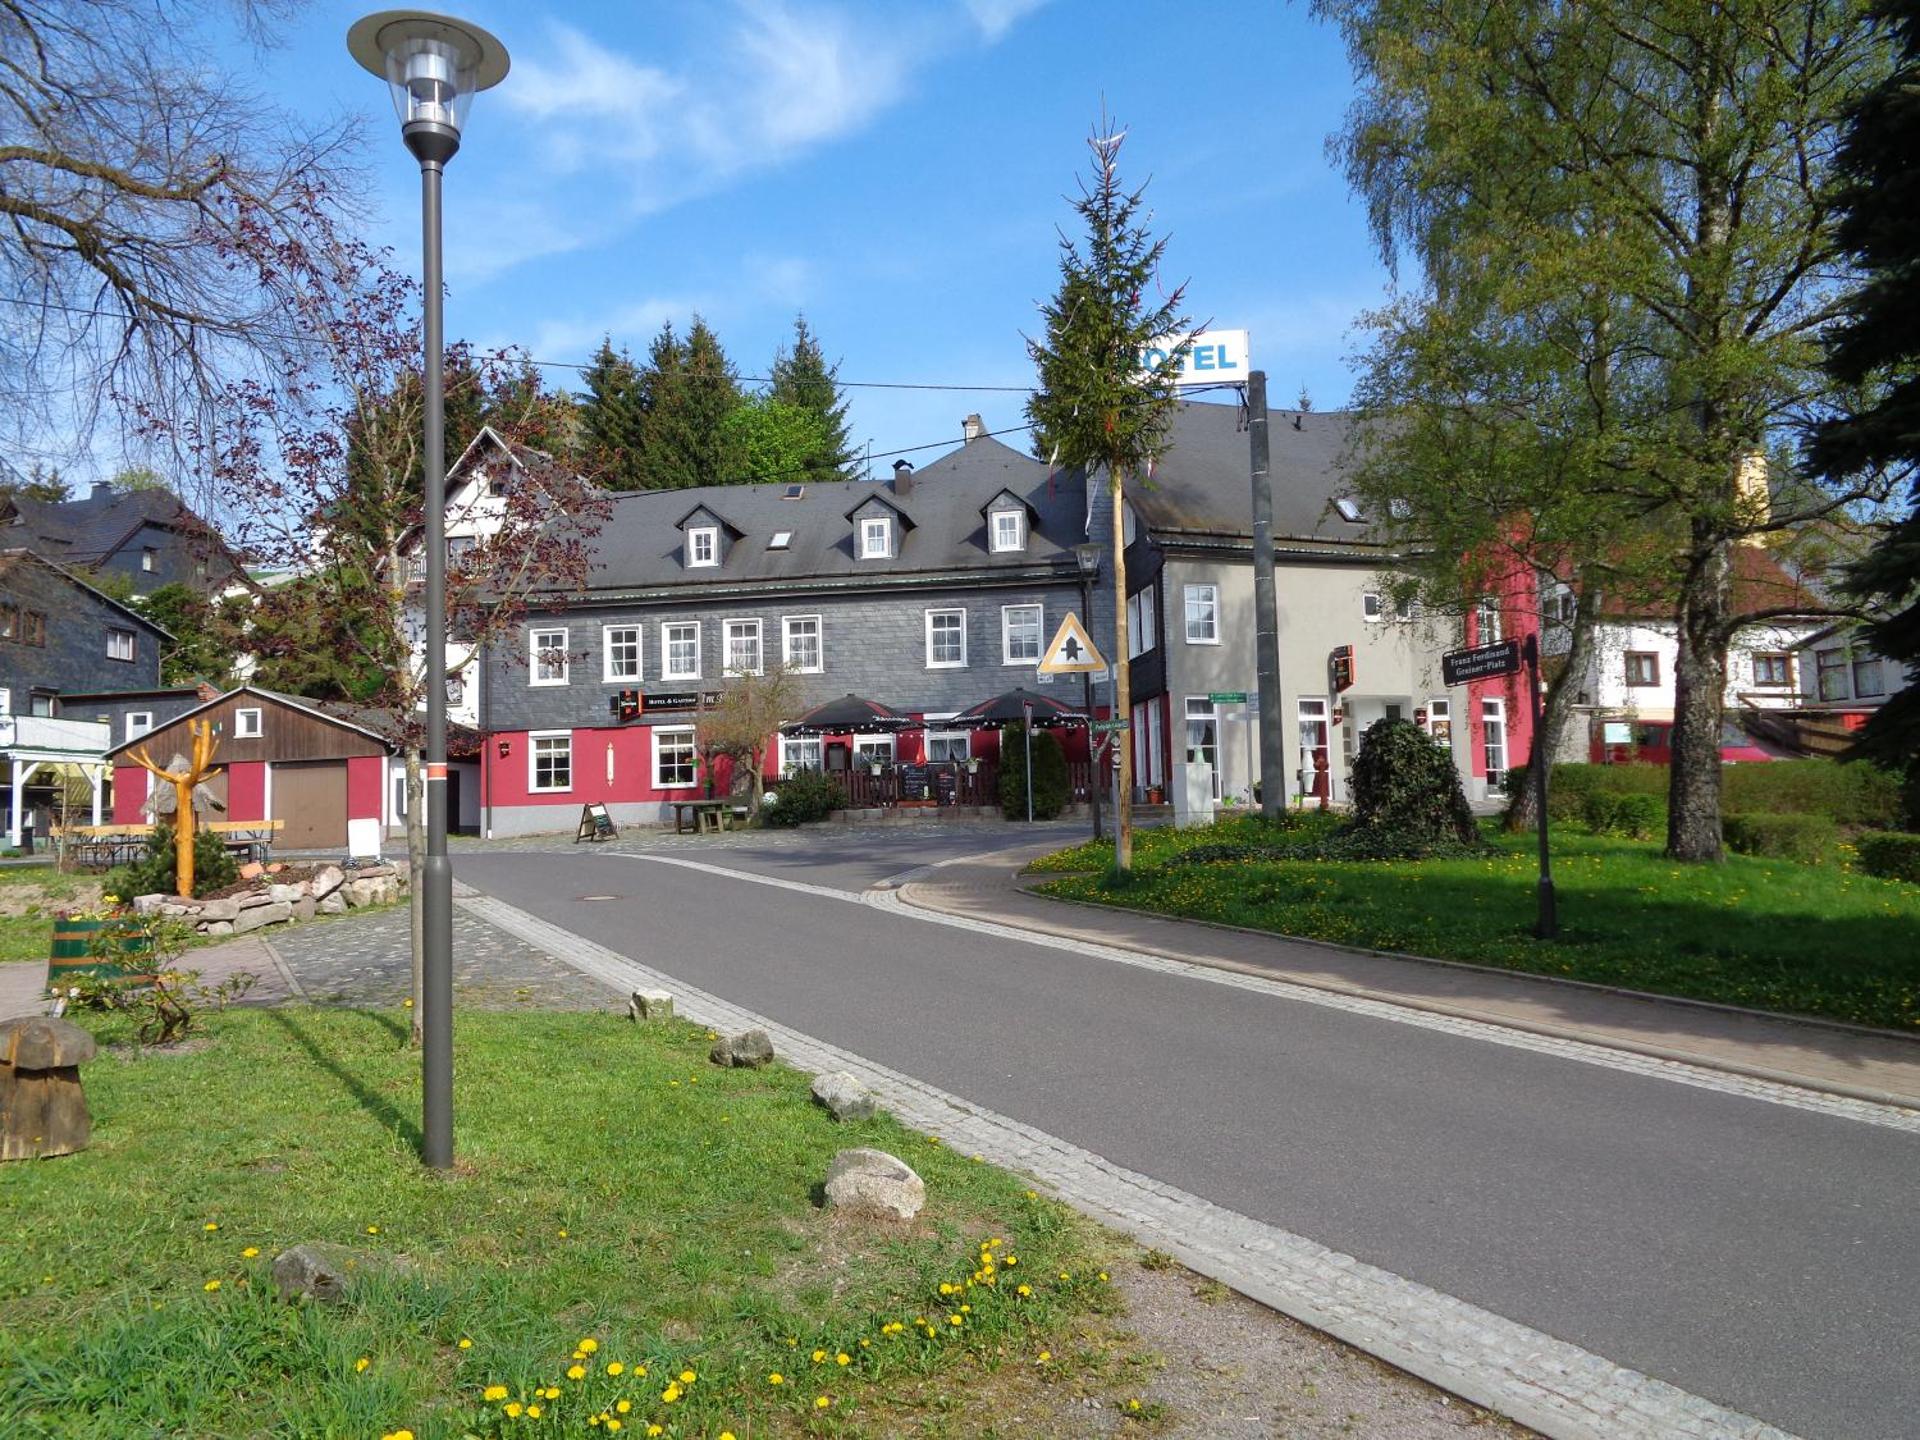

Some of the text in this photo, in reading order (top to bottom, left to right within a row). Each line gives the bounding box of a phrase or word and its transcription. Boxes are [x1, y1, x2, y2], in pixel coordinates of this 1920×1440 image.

[1142, 344, 1237, 373] OEL
[1450, 647, 1510, 667] Franz Ferdinand
[1456, 660, 1506, 676] Greiner-Platz
